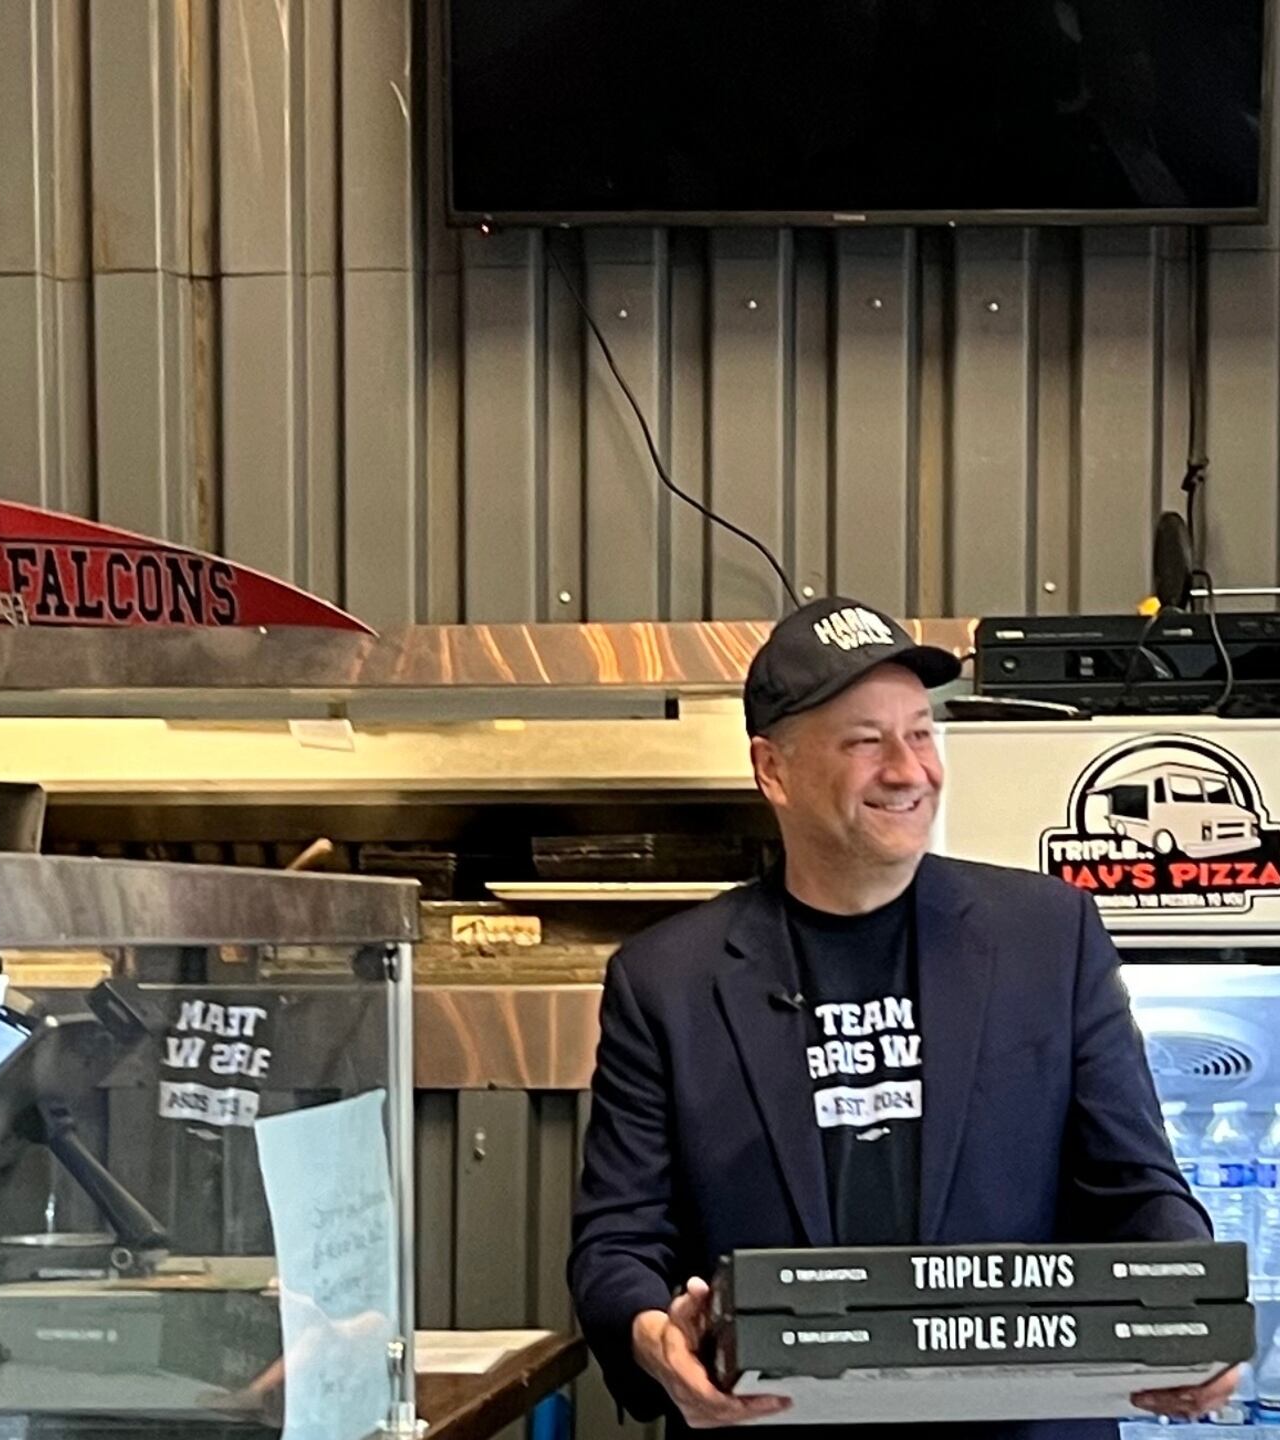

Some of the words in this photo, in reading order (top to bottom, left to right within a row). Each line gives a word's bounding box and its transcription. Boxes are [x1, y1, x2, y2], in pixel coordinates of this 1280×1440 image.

[5, 545, 237, 627] FALCONS
[814, 996, 915, 1036] TEAM
[873, 1090, 914, 1112] 2024
[911, 1255, 1004, 1289] TRIPLE
[1011, 1254, 1075, 1288] JAYS
[912, 1316, 1007, 1350] TRIPLE
[1014, 1315, 1077, 1348] JAYS
